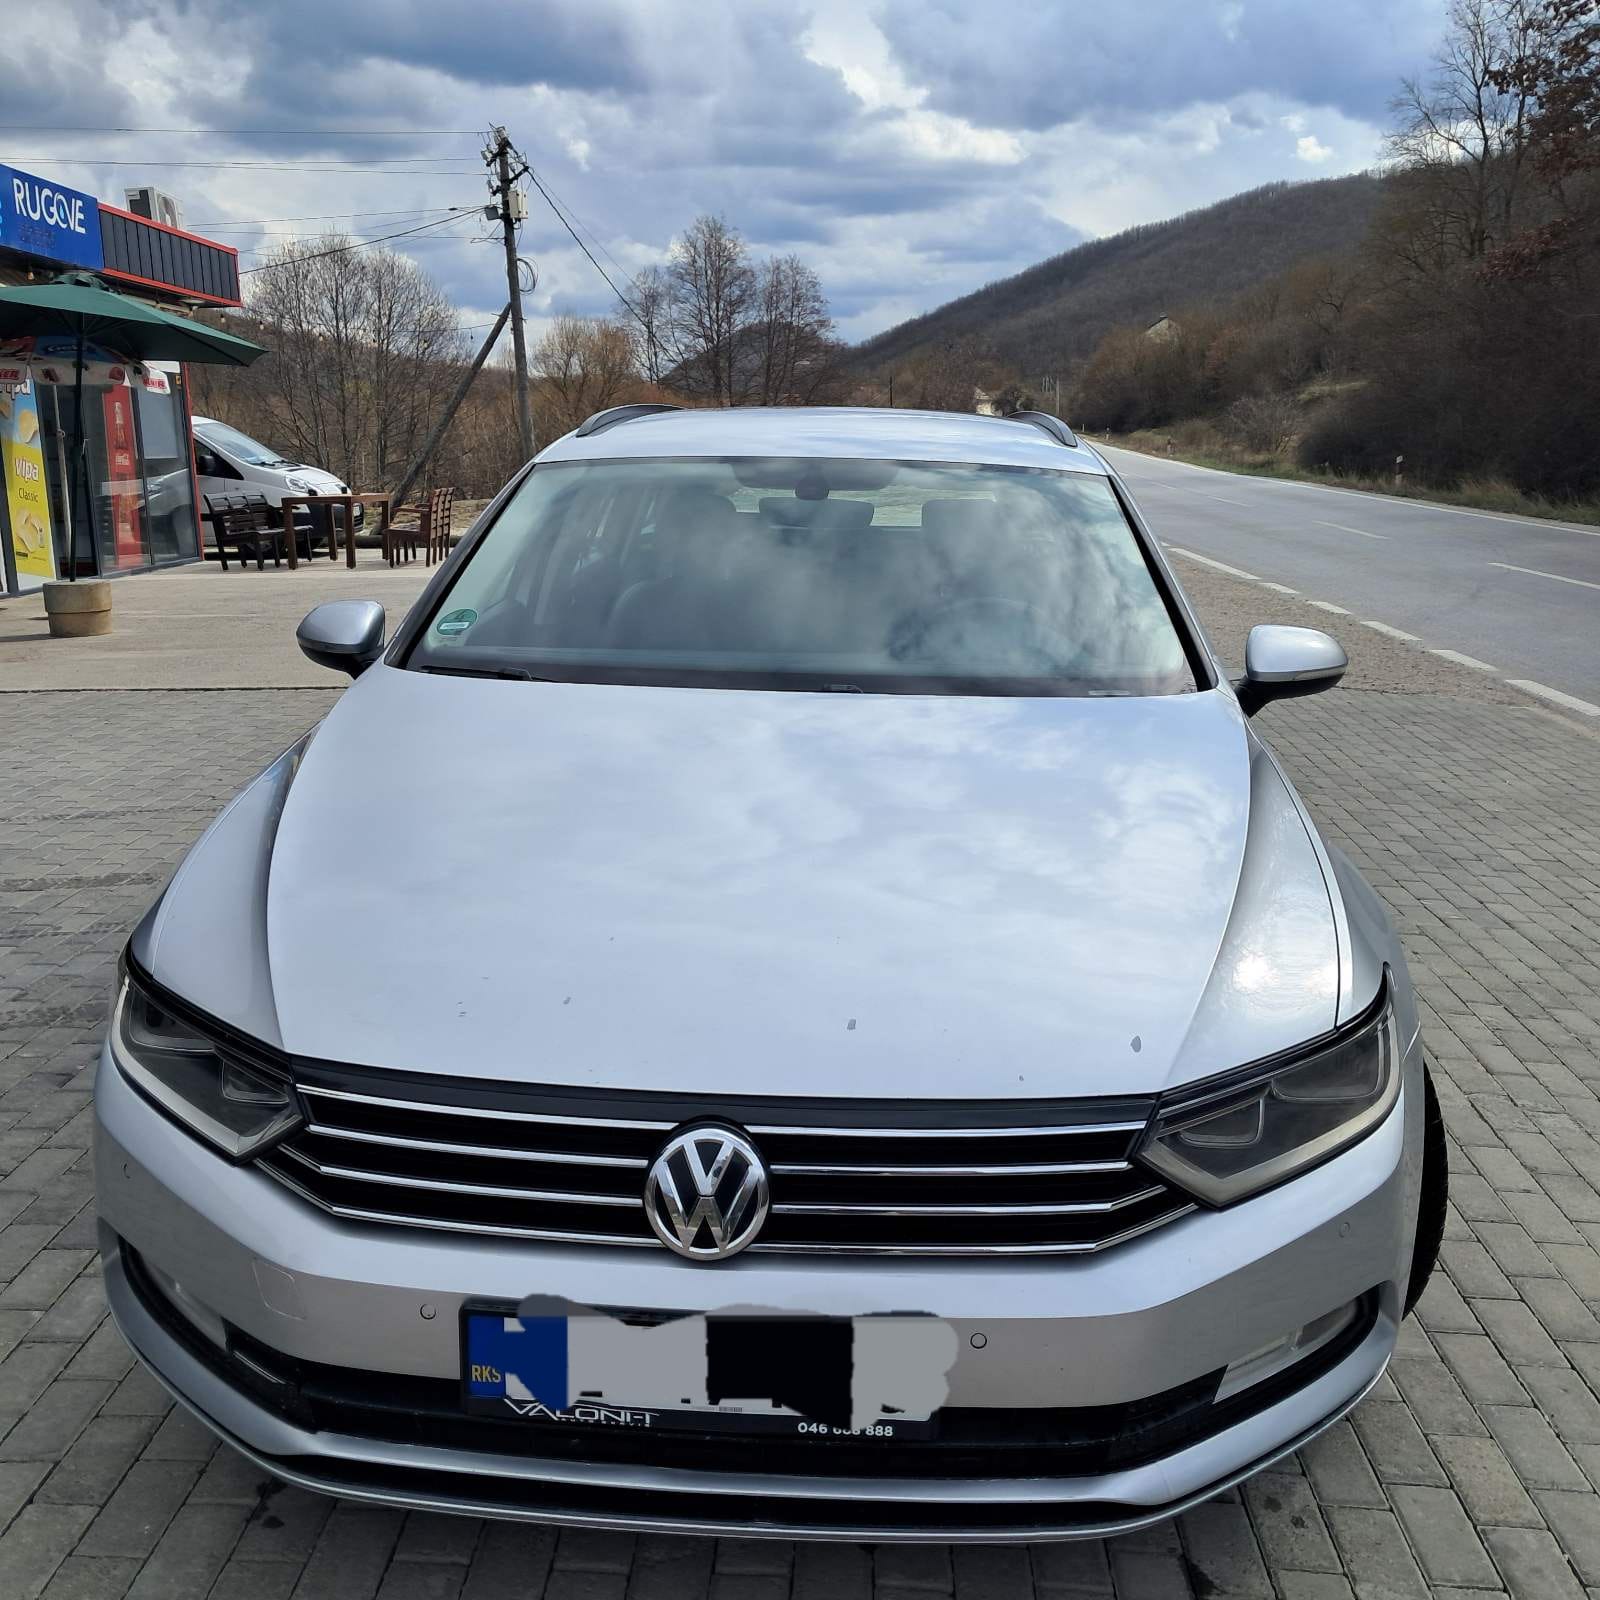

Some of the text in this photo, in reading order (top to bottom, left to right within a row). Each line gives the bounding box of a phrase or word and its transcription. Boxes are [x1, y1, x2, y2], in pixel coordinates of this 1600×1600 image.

[13, 177, 86, 234] RUGOVE
[15, 457, 39, 482] vipa
[18, 487, 39, 503] Classic
[471, 1364, 501, 1383] RKS
[797, 1422, 828, 1434] 046
[865, 1425, 893, 1437] 888
